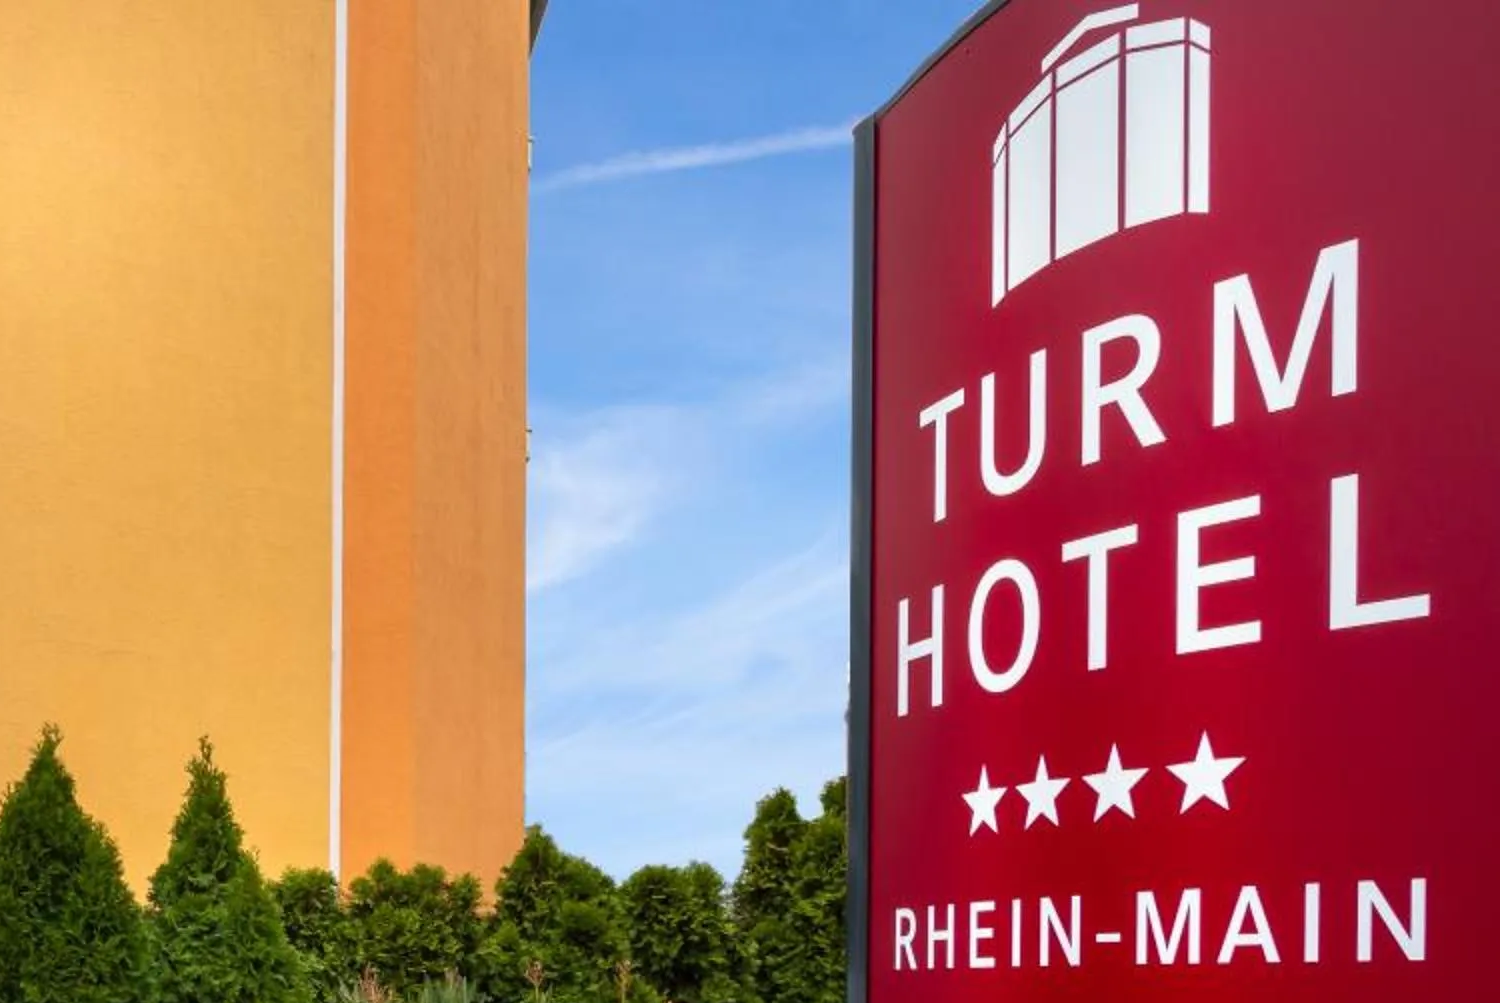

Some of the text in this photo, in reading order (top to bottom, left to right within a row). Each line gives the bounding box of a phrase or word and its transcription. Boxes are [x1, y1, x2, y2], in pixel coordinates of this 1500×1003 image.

[920, 239, 1358, 522] TURM
[898, 473, 1430, 716] HOTEL
[895, 878, 1426, 969] RHEIN-MAIN
